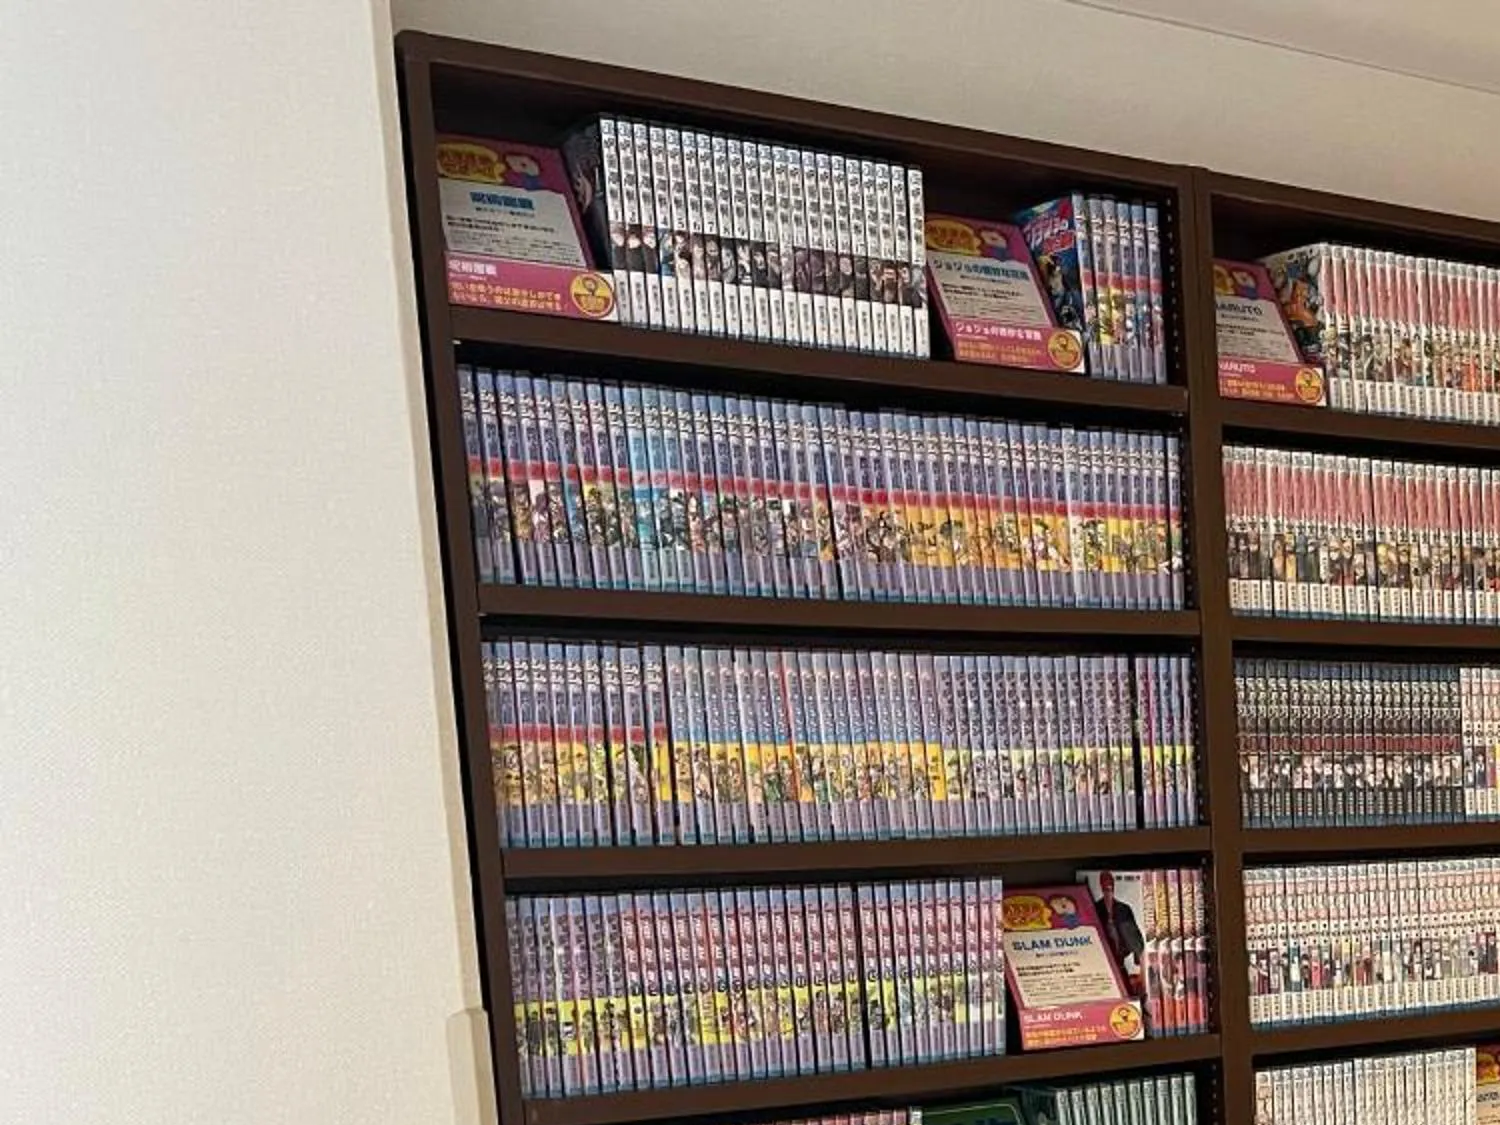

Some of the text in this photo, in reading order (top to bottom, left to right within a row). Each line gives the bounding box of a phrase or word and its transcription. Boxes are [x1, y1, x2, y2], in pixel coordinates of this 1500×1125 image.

[1012, 935, 1093, 951] SLAM DUNK
[1024, 1013, 1053, 1023] SLAM
